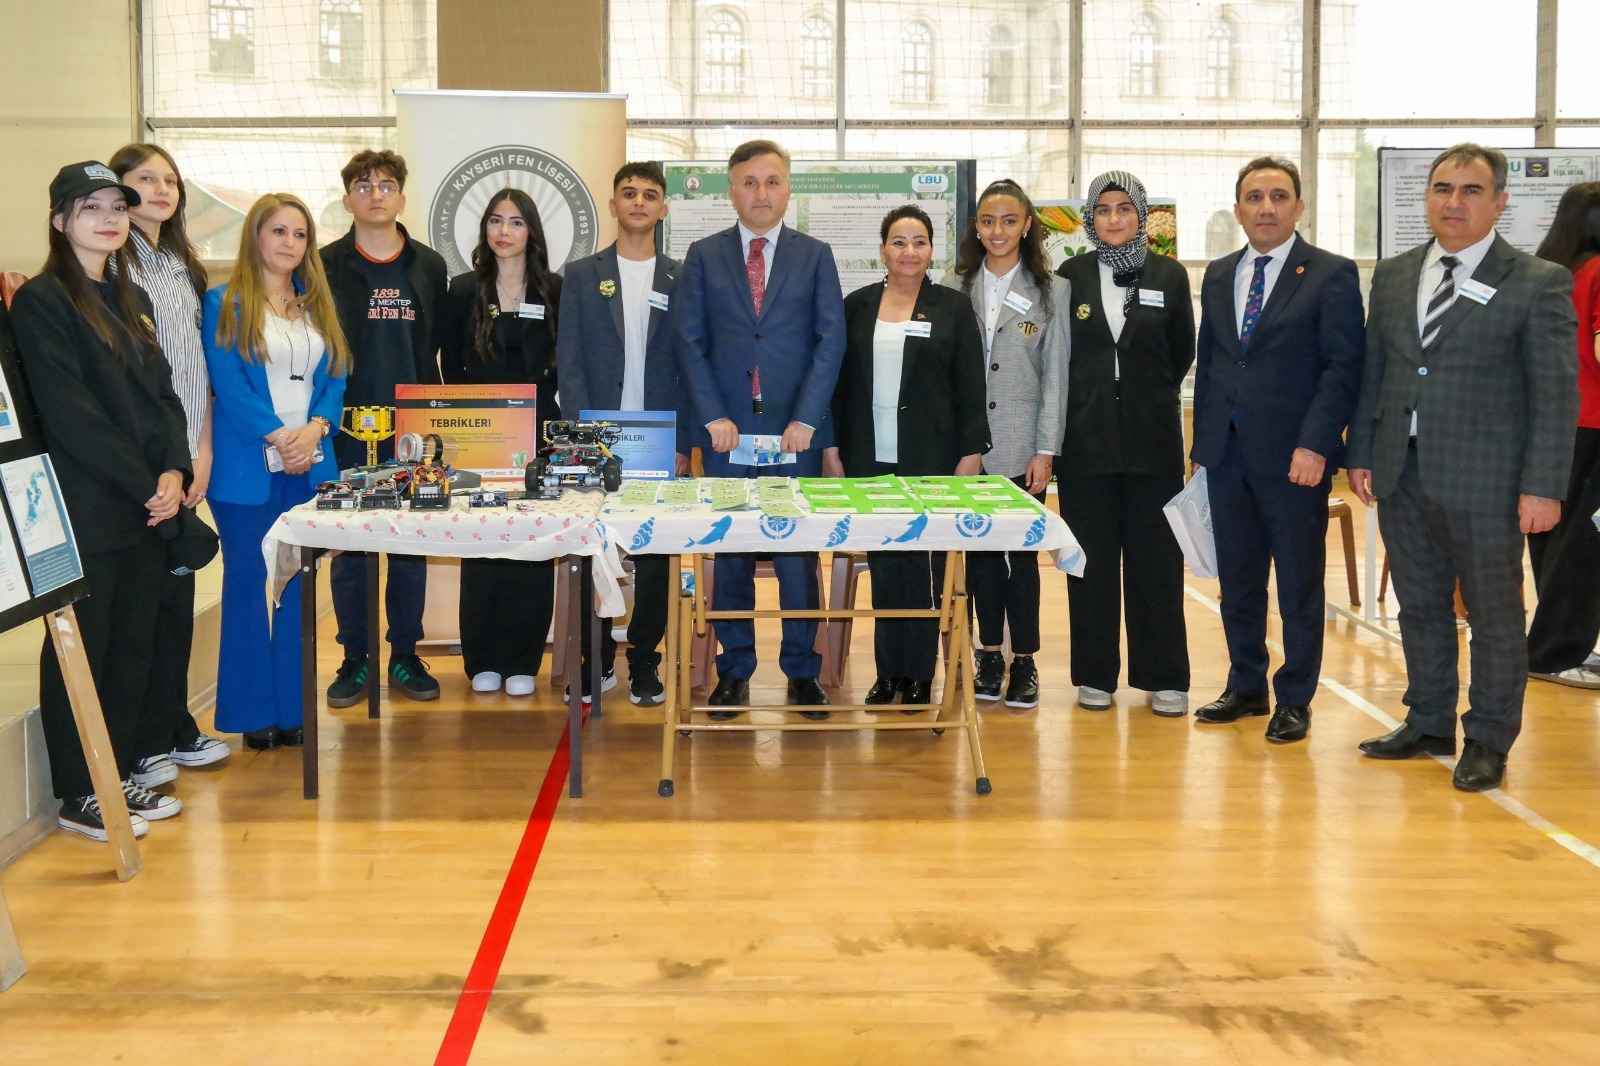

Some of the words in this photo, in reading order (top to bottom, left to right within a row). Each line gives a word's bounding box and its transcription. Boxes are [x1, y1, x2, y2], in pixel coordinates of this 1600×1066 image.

[452, 154, 505, 191] KAYSERİ
[508, 154, 535, 167] FEN
[537, 160, 577, 192] LİSESİ
[371, 288, 400, 299] 1893
[430, 417, 491, 428] TEBRİKLER!
